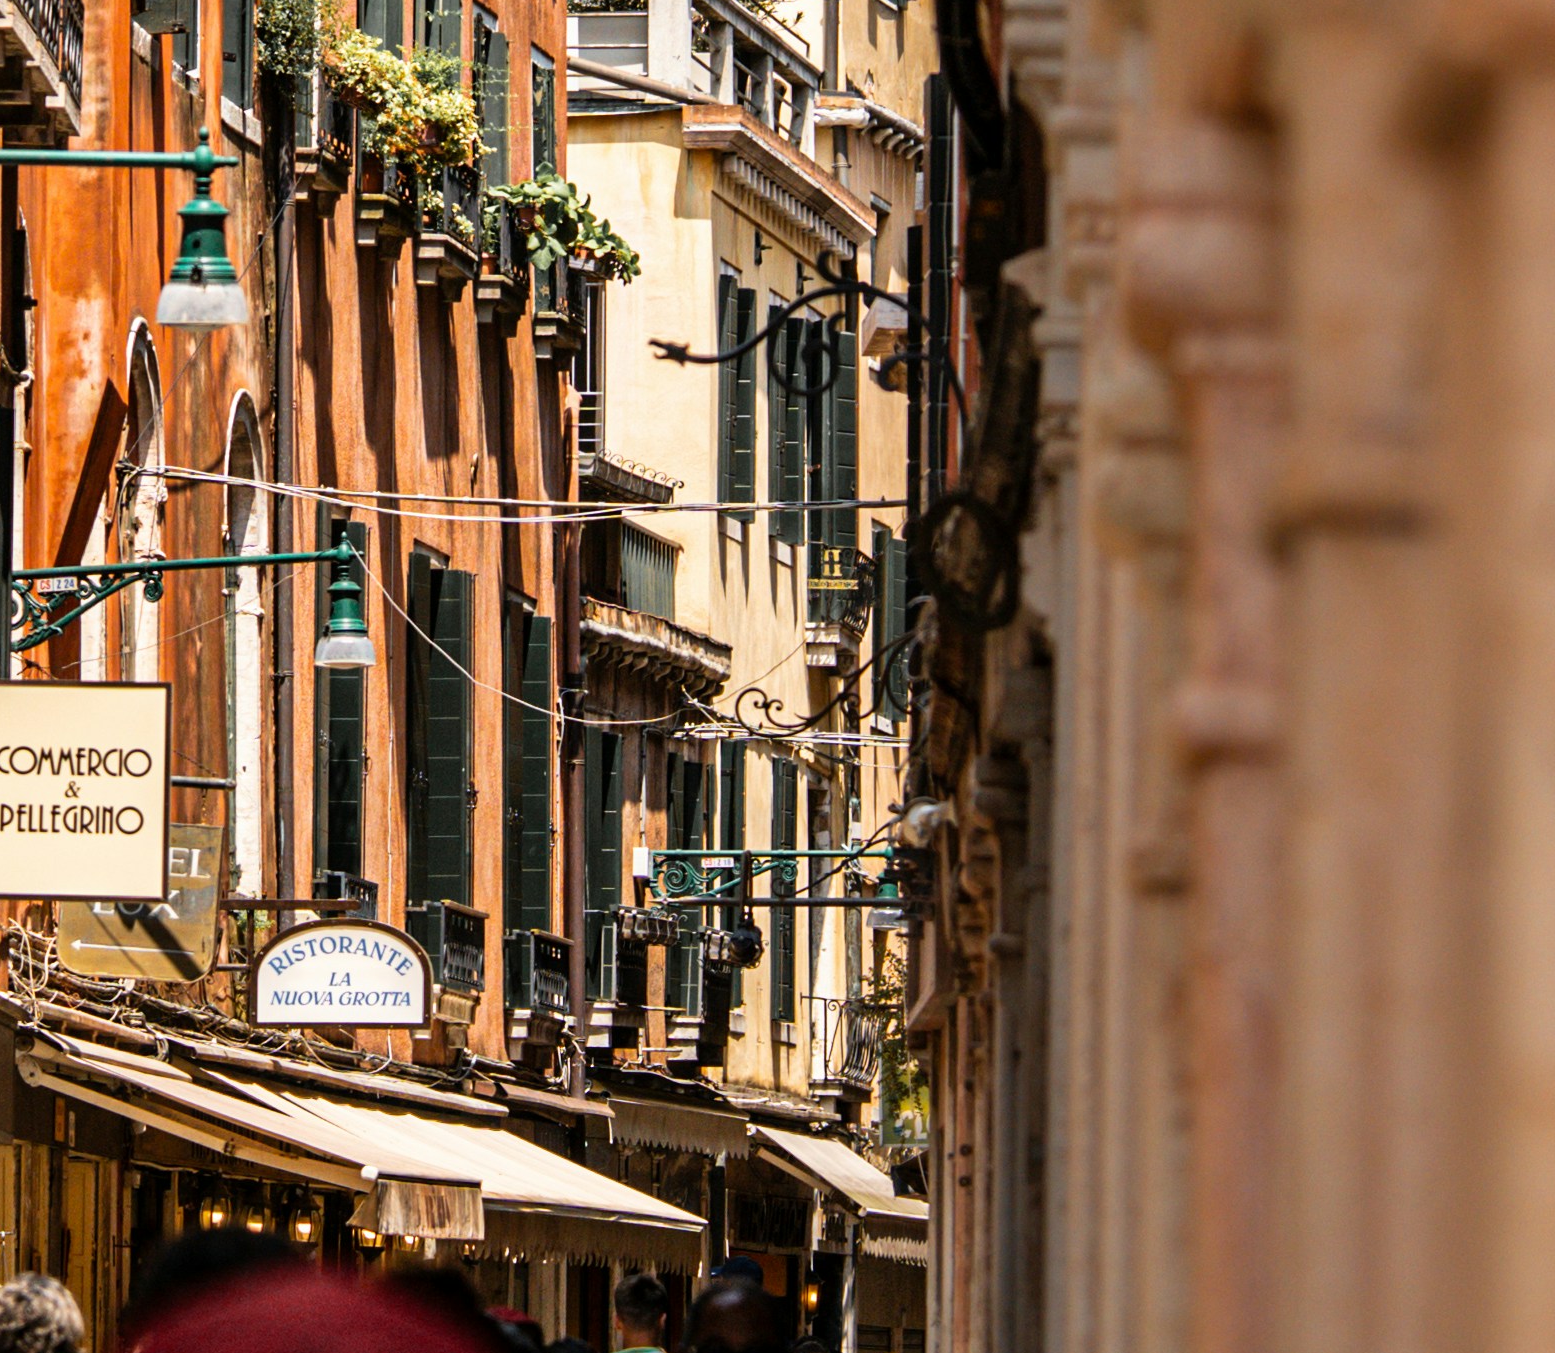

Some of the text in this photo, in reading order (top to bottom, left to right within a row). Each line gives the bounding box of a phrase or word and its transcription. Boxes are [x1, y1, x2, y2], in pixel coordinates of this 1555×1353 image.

[40, 578, 75, 590] CS Z 24
[64, 780, 81, 799] &
[0, 803, 145, 835] PELLEGRINO
[267, 935, 414, 976] RISTORANTE
[328, 972, 352, 987] LA
[270, 991, 412, 1007] NUOVA GROTTA
